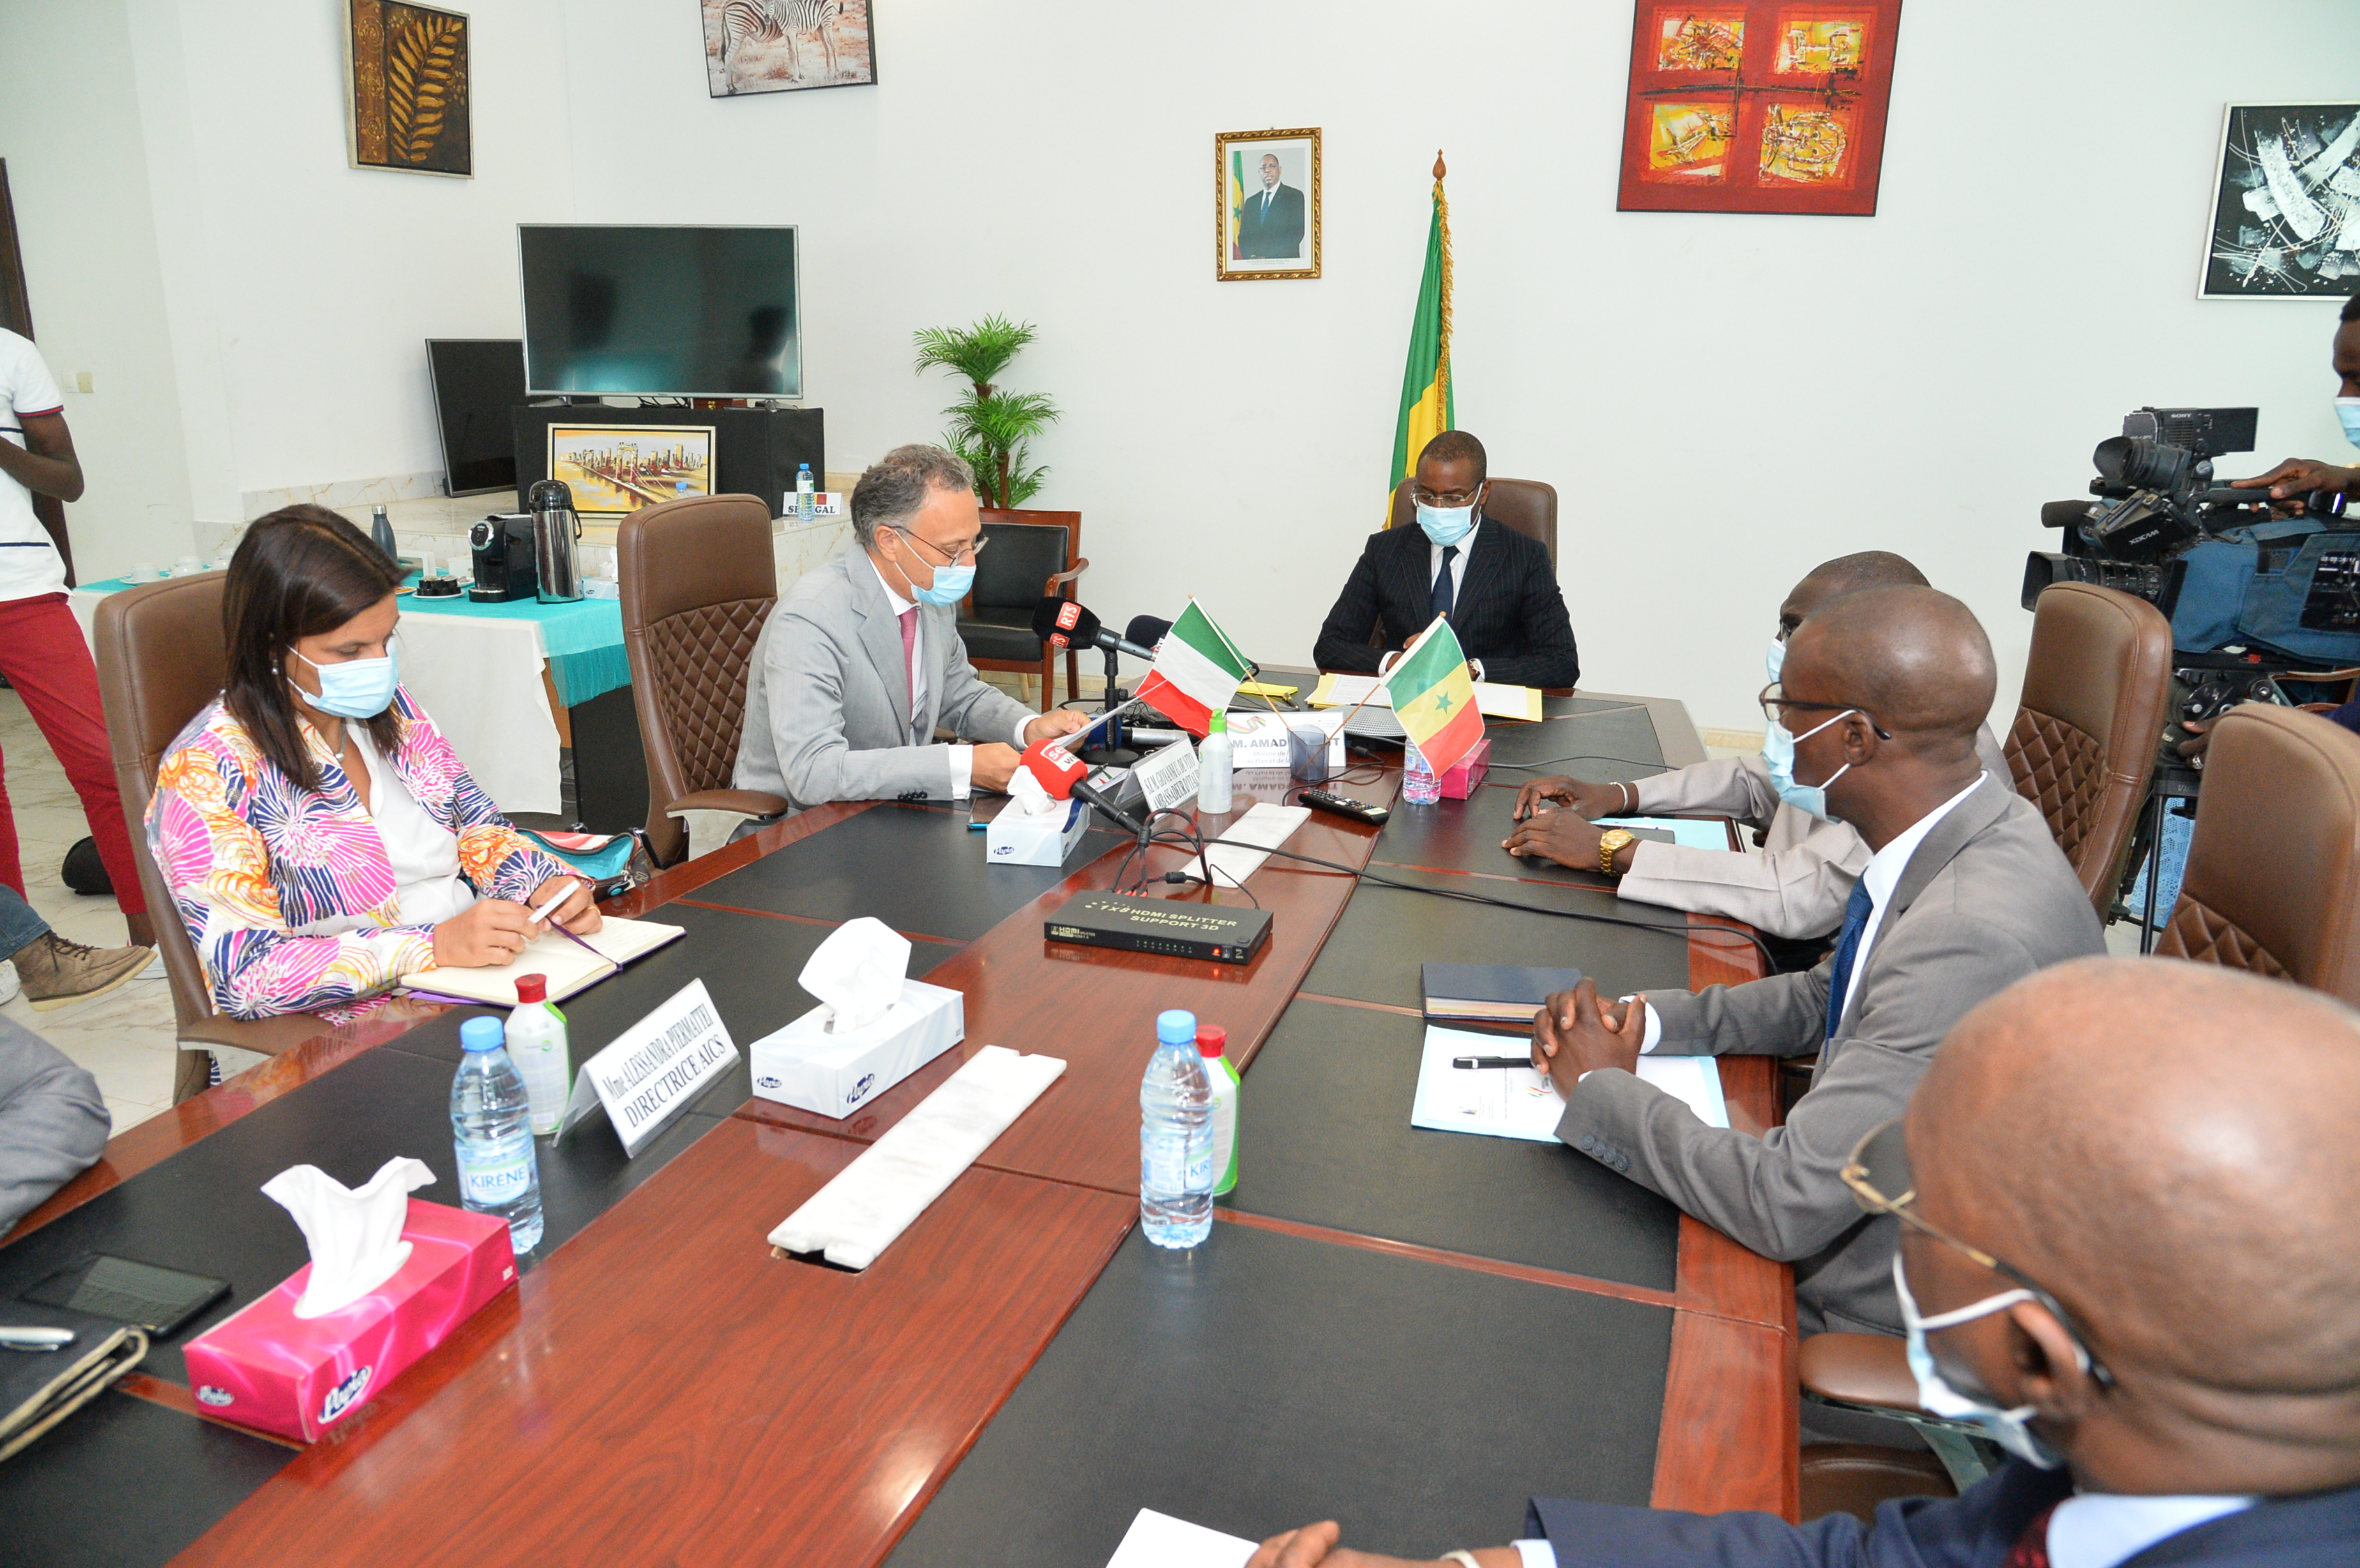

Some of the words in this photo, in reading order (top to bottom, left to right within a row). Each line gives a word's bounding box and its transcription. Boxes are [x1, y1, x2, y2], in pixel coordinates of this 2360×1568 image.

[787, 505, 835, 513] SEGAL
[1060, 605, 1077, 627] RTS
[1048, 746, 1064, 760] se
[1250, 739, 1287, 748] AMAD
[1177, 758, 1187, 773] DE
[1182, 752, 1195, 769] VITO
[1153, 780, 1187, 810] AMBASSADEUR
[1130, 908, 1167, 919] HDMI
[1168, 913, 1237, 927] SPLITTER
[1130, 916, 1200, 929] SUPPORT
[1059, 926, 1080, 935] HDMI
[603, 1076, 629, 1103] Mme
[621, 1033, 675, 1090] ALESSANDRA
[665, 1003, 713, 1053] PIERMATTEI
[623, 1055, 701, 1128] DIRECTRICE
[698, 1034, 725, 1069] AICS
[757, 1076, 782, 1089] Papia
[846, 1073, 875, 1104] Papia
[198, 1385, 234, 1406] Papia
[319, 1366, 372, 1424] Papia
